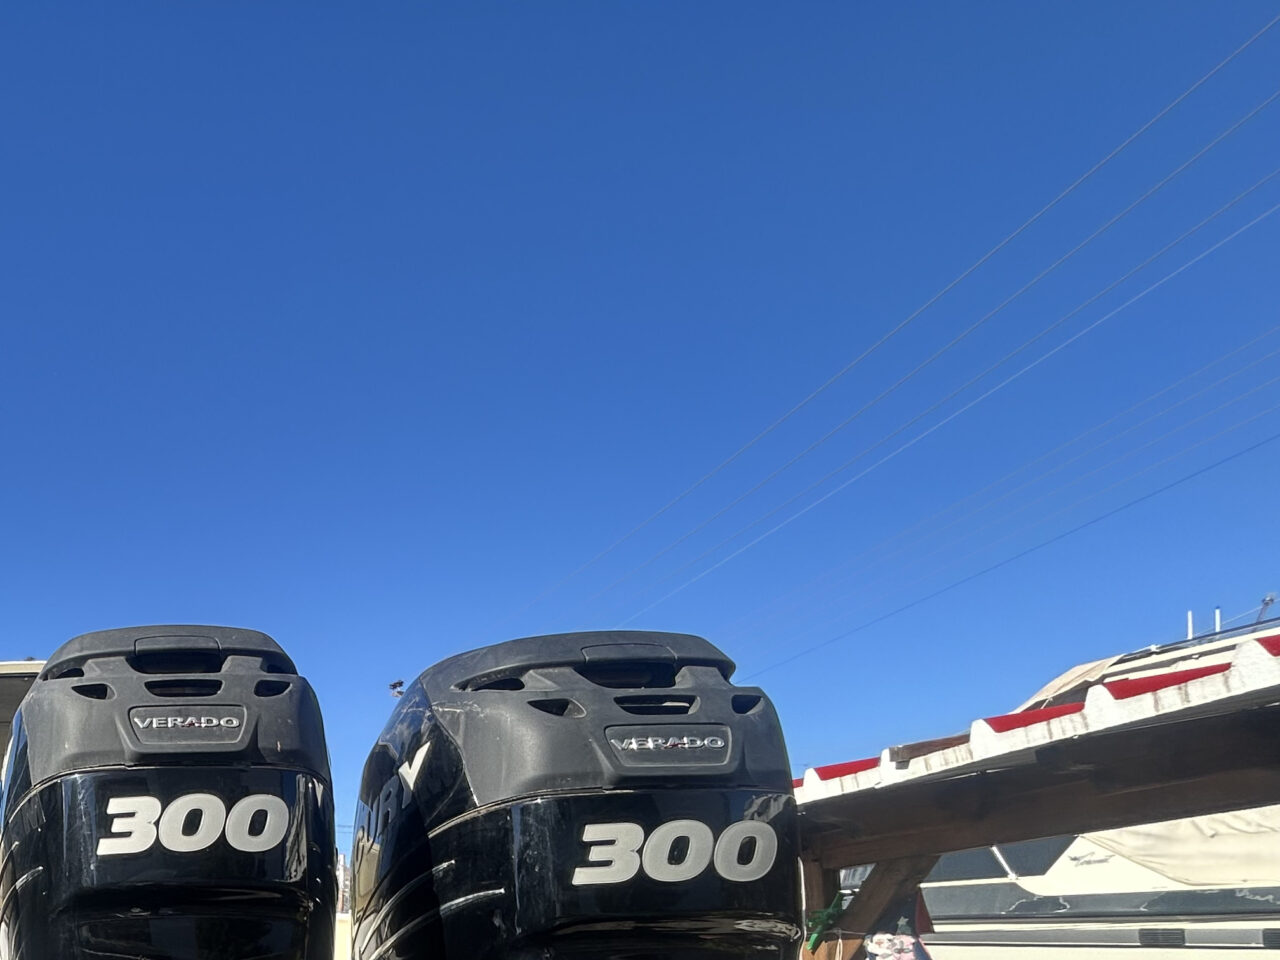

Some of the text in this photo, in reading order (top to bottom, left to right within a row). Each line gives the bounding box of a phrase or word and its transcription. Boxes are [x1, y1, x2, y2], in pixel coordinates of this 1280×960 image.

[133, 716, 241, 730] VERADO
[610, 736, 725, 751] VERADO
[96, 793, 290, 857] 300
[572, 819, 779, 887] 300
